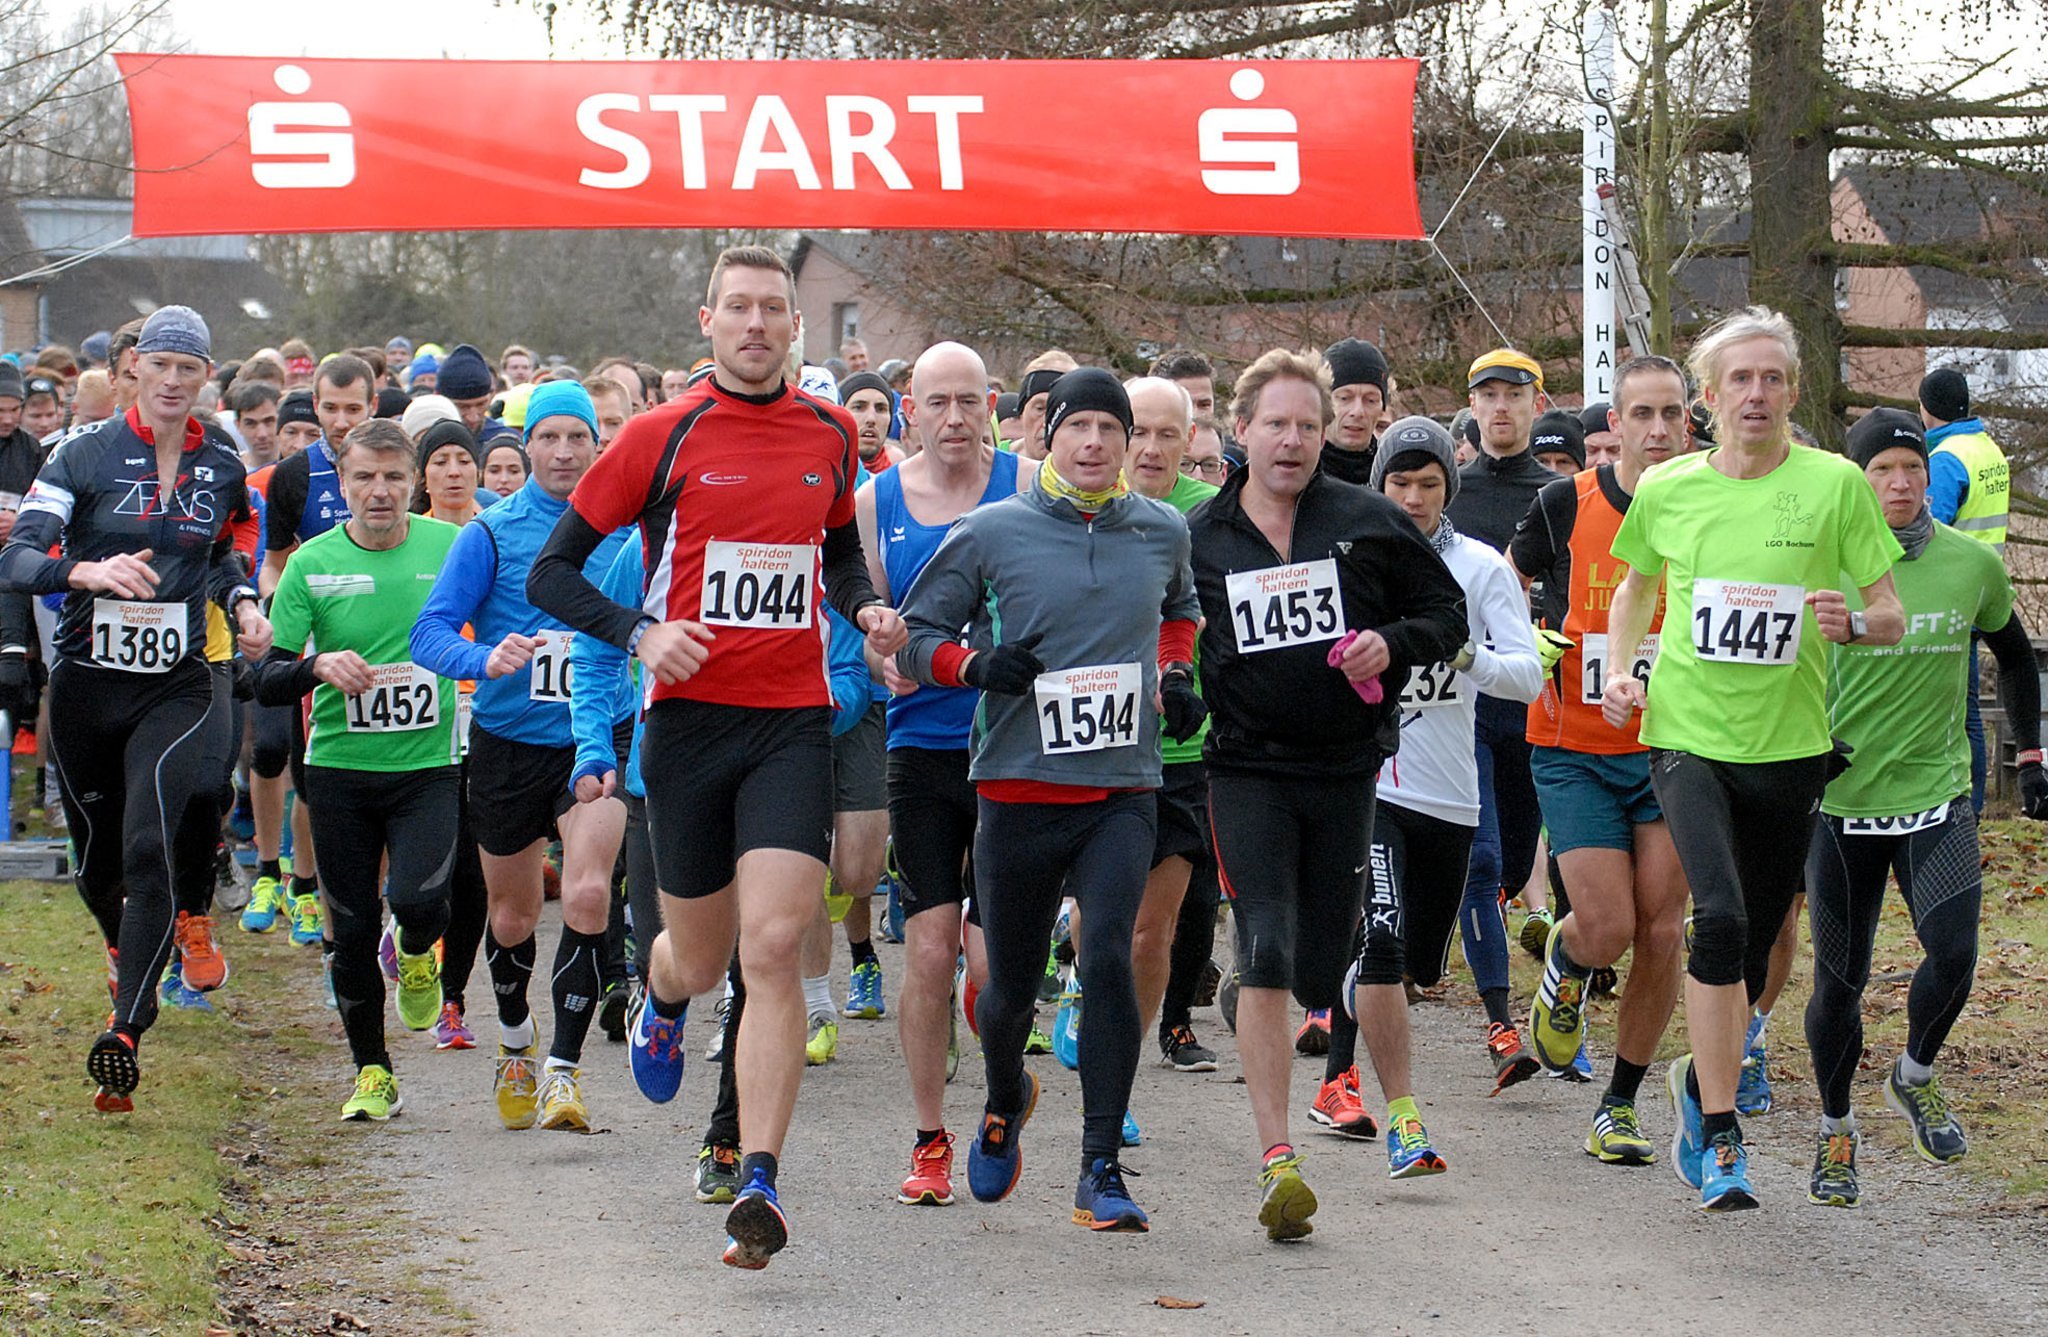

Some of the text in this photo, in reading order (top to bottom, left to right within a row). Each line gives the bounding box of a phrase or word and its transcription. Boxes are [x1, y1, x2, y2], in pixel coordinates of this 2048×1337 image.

[576, 93, 984, 189] START
[1594, 88, 1611, 404] SPIRDON HAL
[1765, 540, 1815, 548] LGO Bochum
[737, 547, 792, 560] spiridon
[741, 559, 789, 570] haltern
[1255, 567, 1309, 583] spiridon
[1262, 578, 1308, 593] haltern
[1721, 584, 1777, 598] spiridon
[705, 570, 805, 623] 1044
[1725, 596, 1773, 608] haltern
[119, 605, 164, 616] spiridon
[1235, 586, 1337, 647] 1453
[122, 615, 161, 625] haltern
[1904, 612, 1946, 635] FT
[1695, 606, 1797, 660] 1447
[96, 622, 181, 668] 1389
[1910, 643, 1962, 655] Friends
[372, 665, 413, 675] piridon
[1065, 669, 1118, 684] spiridon
[1072, 682, 1117, 694] haltern
[348, 683, 434, 728] 1452
[1043, 692, 1135, 749] 1544
